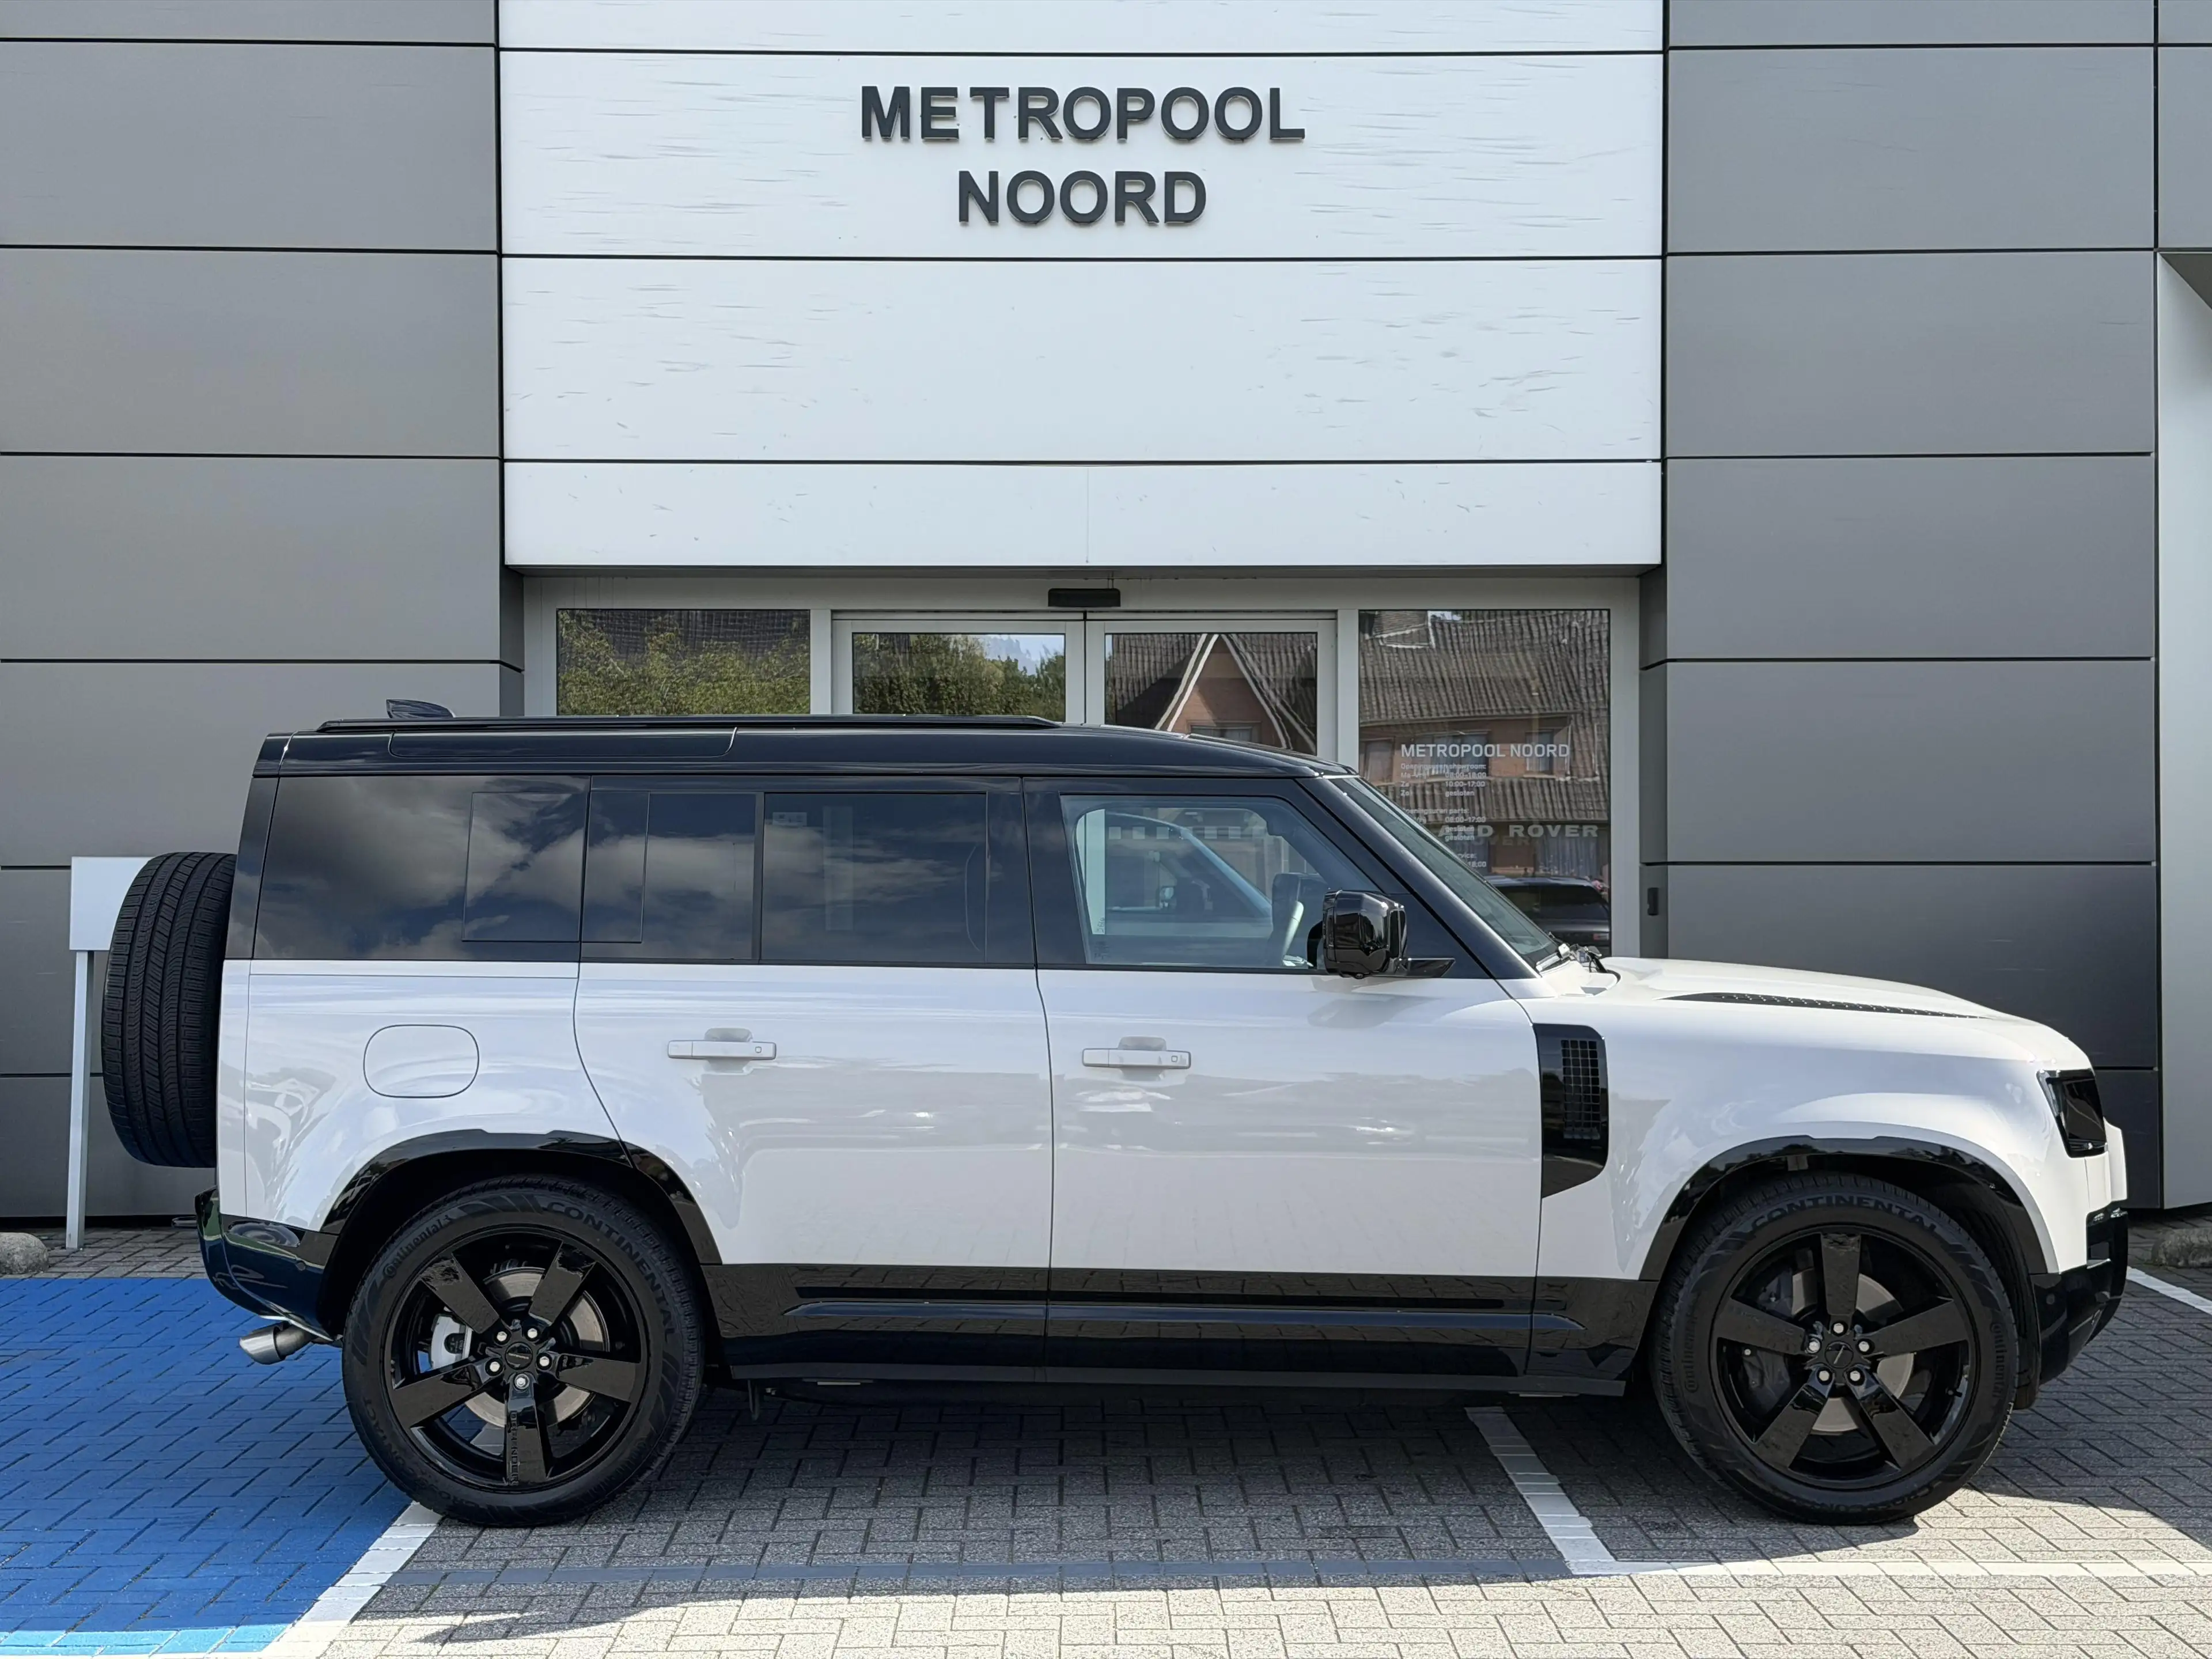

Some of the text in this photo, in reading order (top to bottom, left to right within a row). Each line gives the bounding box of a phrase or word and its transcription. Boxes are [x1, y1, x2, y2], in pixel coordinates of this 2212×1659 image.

[861, 86, 1306, 142] METROPOOL
[958, 170, 1207, 225] NOORD
[1401, 744, 1569, 757] METROPOOL NOORD
[1437, 824, 1599, 837] AND ROVER
[1751, 1195, 1937, 1233] CONTINENTAL
[382, 1218, 446, 1279] Continental
[546, 1201, 676, 1344] CONTINENTAL
[1990, 1321, 2007, 1397] Continental
